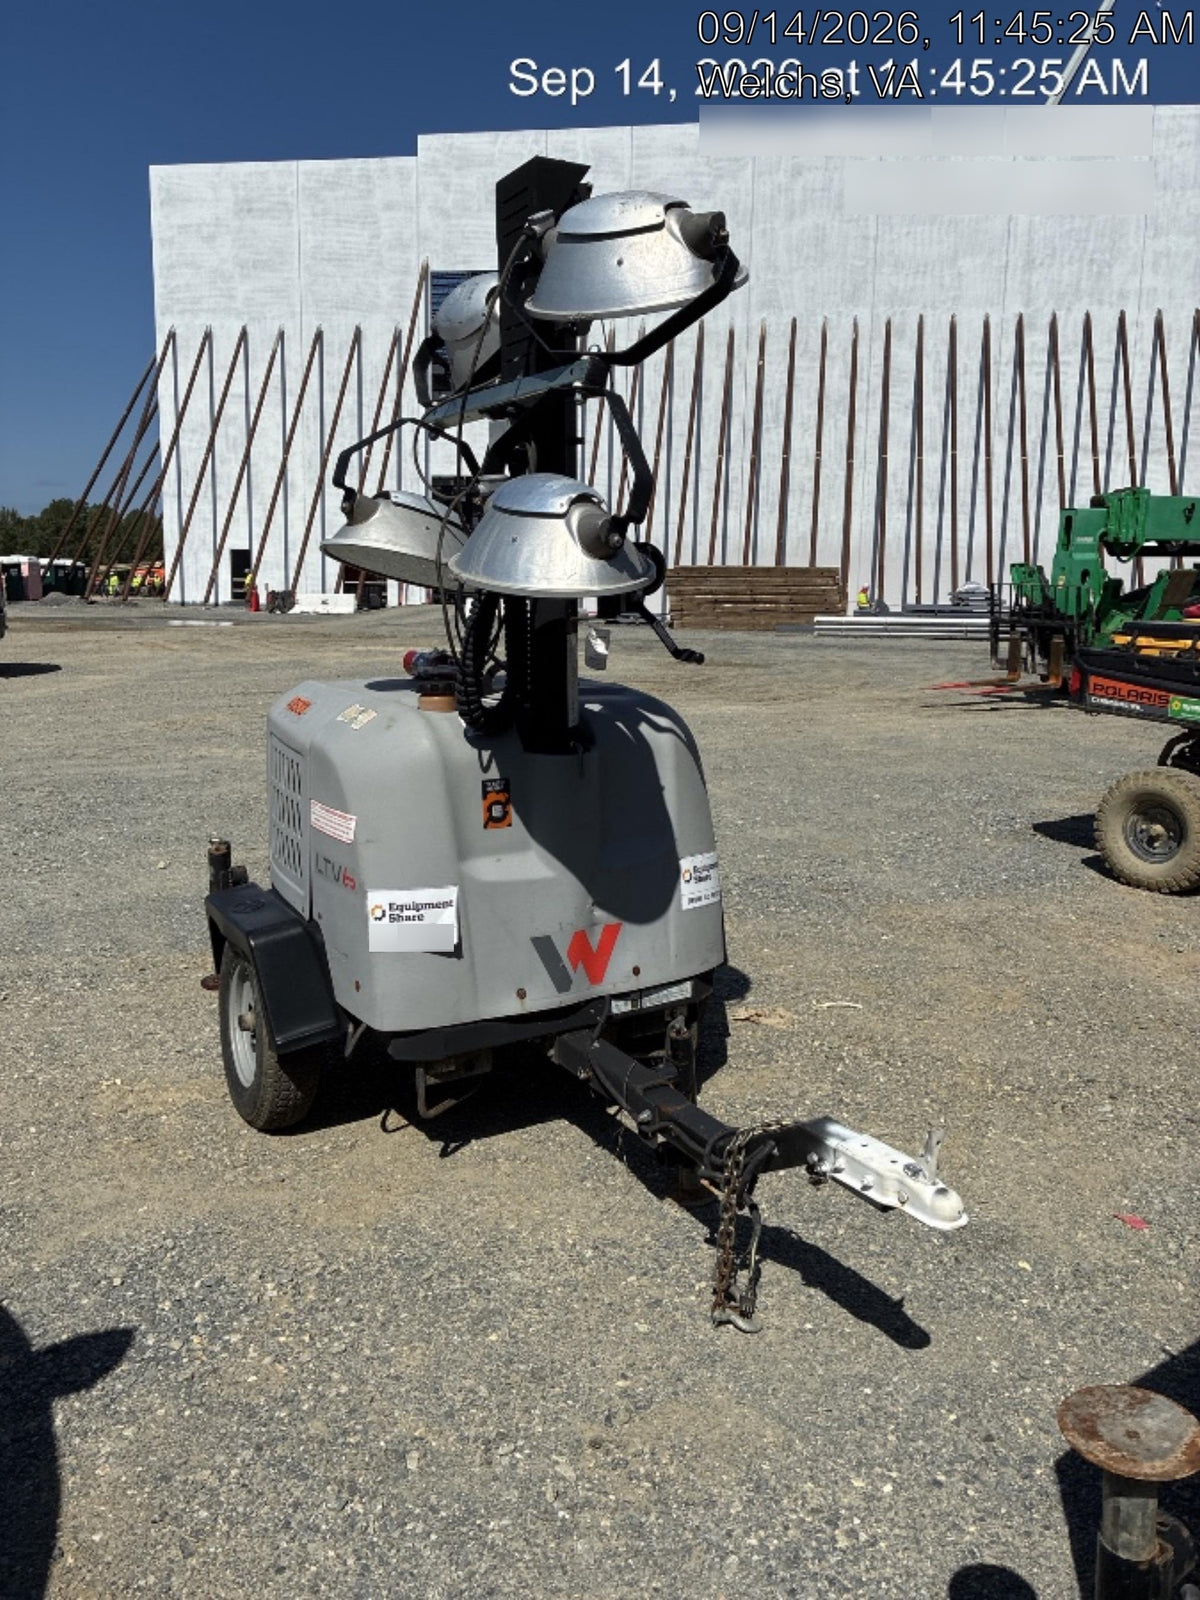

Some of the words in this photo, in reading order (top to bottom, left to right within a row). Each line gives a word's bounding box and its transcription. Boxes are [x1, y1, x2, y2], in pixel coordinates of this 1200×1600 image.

[1093, 682, 1169, 708] POLARIS
[388, 899, 455, 913] Equipment
[388, 913, 425, 924] Share
